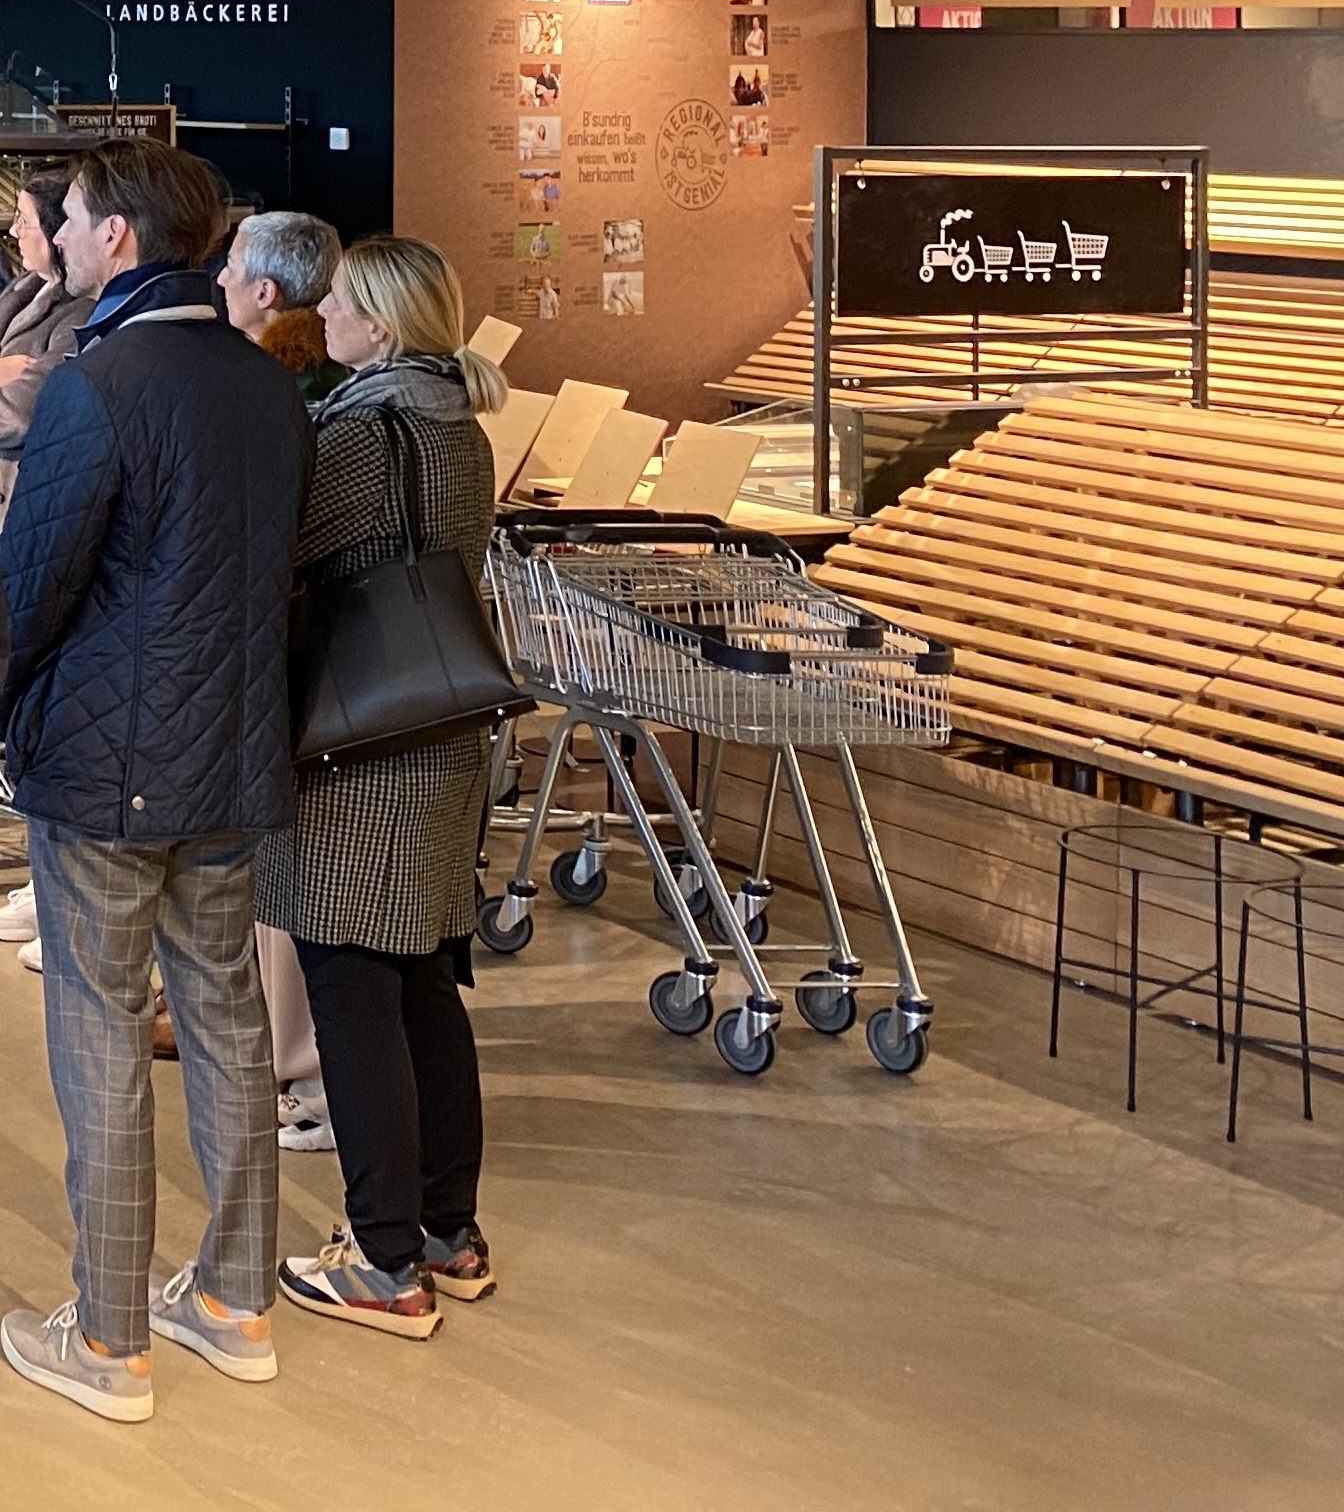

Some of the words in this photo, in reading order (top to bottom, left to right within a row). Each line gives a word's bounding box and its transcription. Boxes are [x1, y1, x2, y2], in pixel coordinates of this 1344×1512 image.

[106, 1, 289, 23] LANDBÄCKEREI
[68, 115, 132, 127] GESCHNITTNES
[583, 111, 631, 131] B'sundrig
[663, 105, 729, 148] REGIONAL
[567, 130, 621, 146] einkaufen
[578, 167, 635, 183] herkommt
